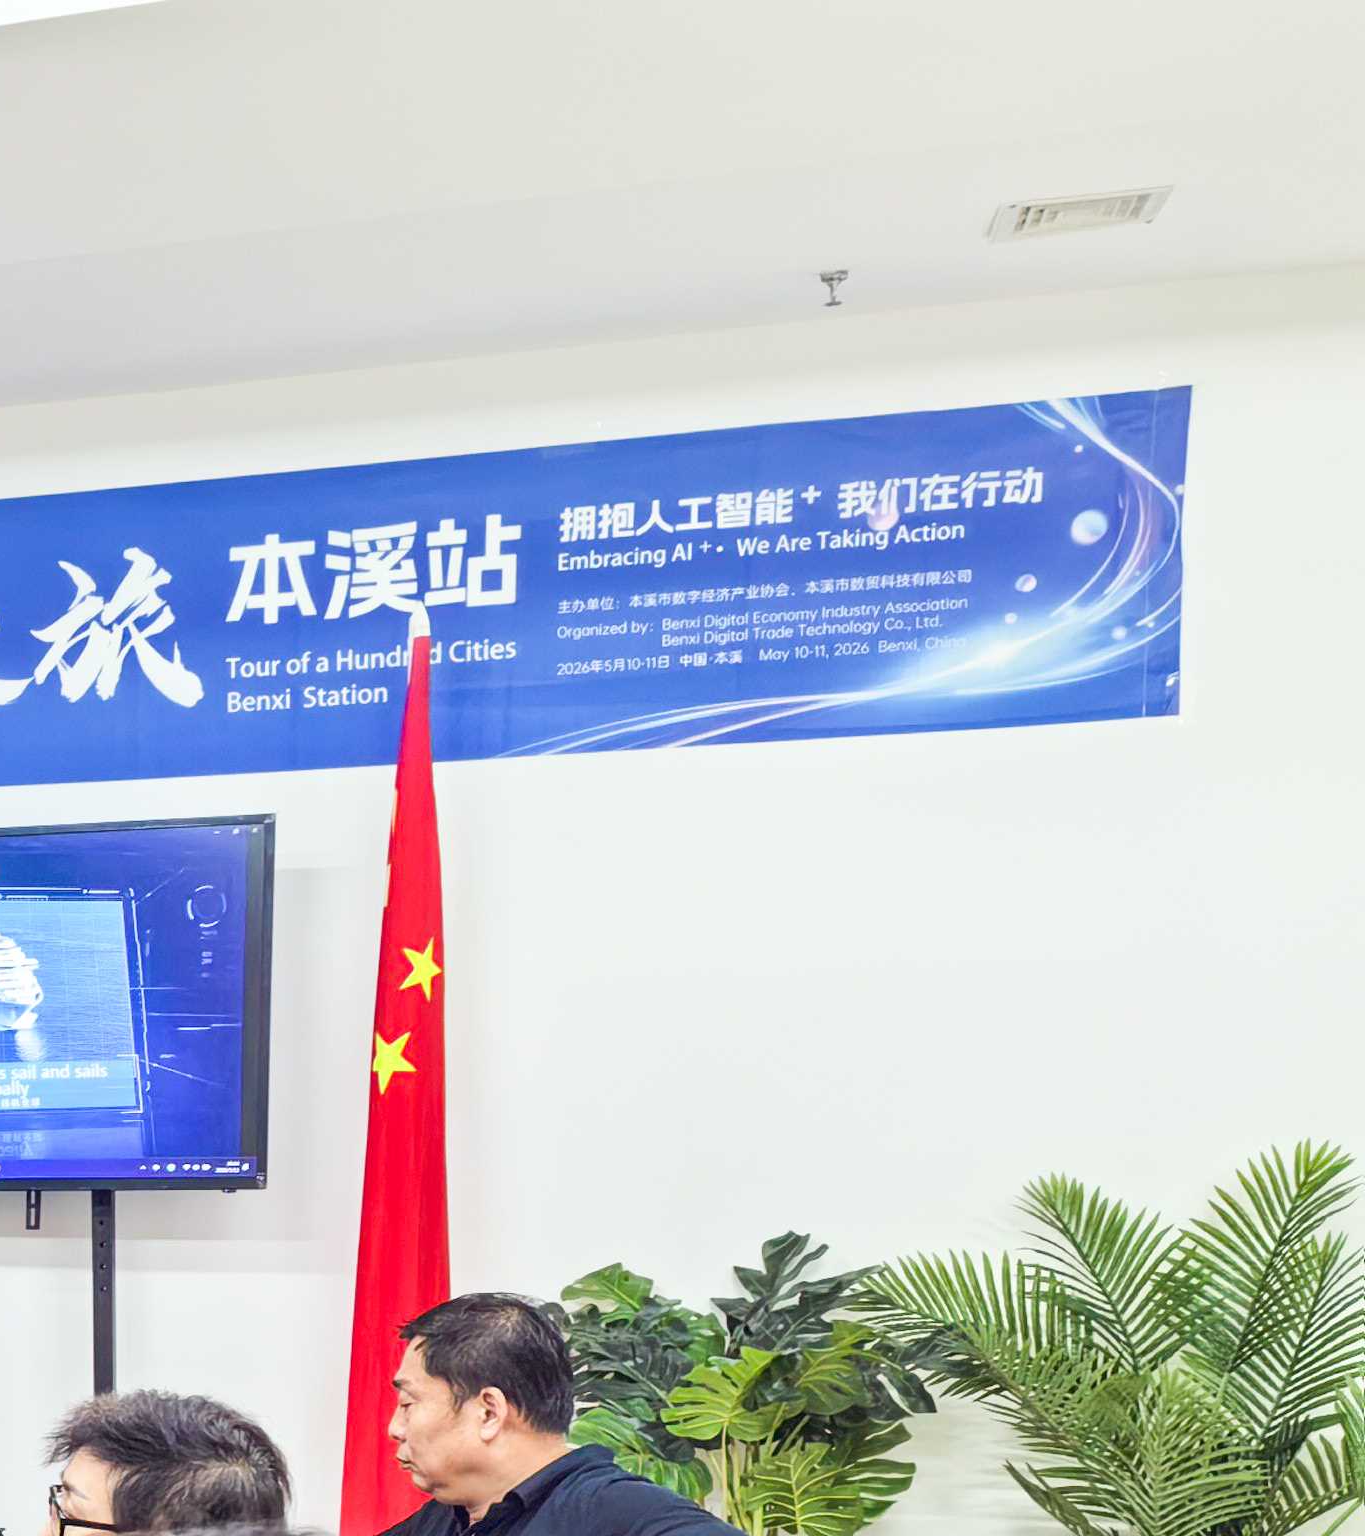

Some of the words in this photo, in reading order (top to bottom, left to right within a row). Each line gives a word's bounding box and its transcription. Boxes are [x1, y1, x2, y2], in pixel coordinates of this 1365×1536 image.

[838, 466, 1044, 518] 我们在行动
[557, 548, 666, 573] Embracing
[671, 543, 694, 562] AI
[737, 537, 770, 558] We
[775, 533, 811, 554] Are
[817, 528, 889, 554] Taking
[895, 522, 965, 546] Action
[225, 514, 522, 624] 本溪站
[557, 623, 628, 641] Organized
[662, 617, 701, 632] Benxi
[704, 614, 749, 631] Digital
[752, 609, 818, 625] Economy
[821, 603, 881, 620] Industry
[884, 597, 968, 614] Association
[662, 633, 701, 648] Benxi
[704, 630, 749, 647] Digital
[752, 625, 793, 641] Trade
[798, 620, 880, 638] Technology
[915, 614, 943, 629] Ltd.
[225, 656, 279, 679] Tour
[286, 651, 310, 675] of
[316, 656, 329, 673] a
[449, 640, 517, 663] Cities
[557, 656, 670, 676] 2026年5月10-11日
[759, 648, 789, 662] May
[834, 642, 869, 657] 2026
[924, 636, 966, 650] China
[226, 688, 291, 713] Benxi
[303, 684, 389, 709] Station
[10, 1065, 37, 1081] sail
[41, 1065, 70, 1080] and
[74, 1063, 108, 1079] sails
